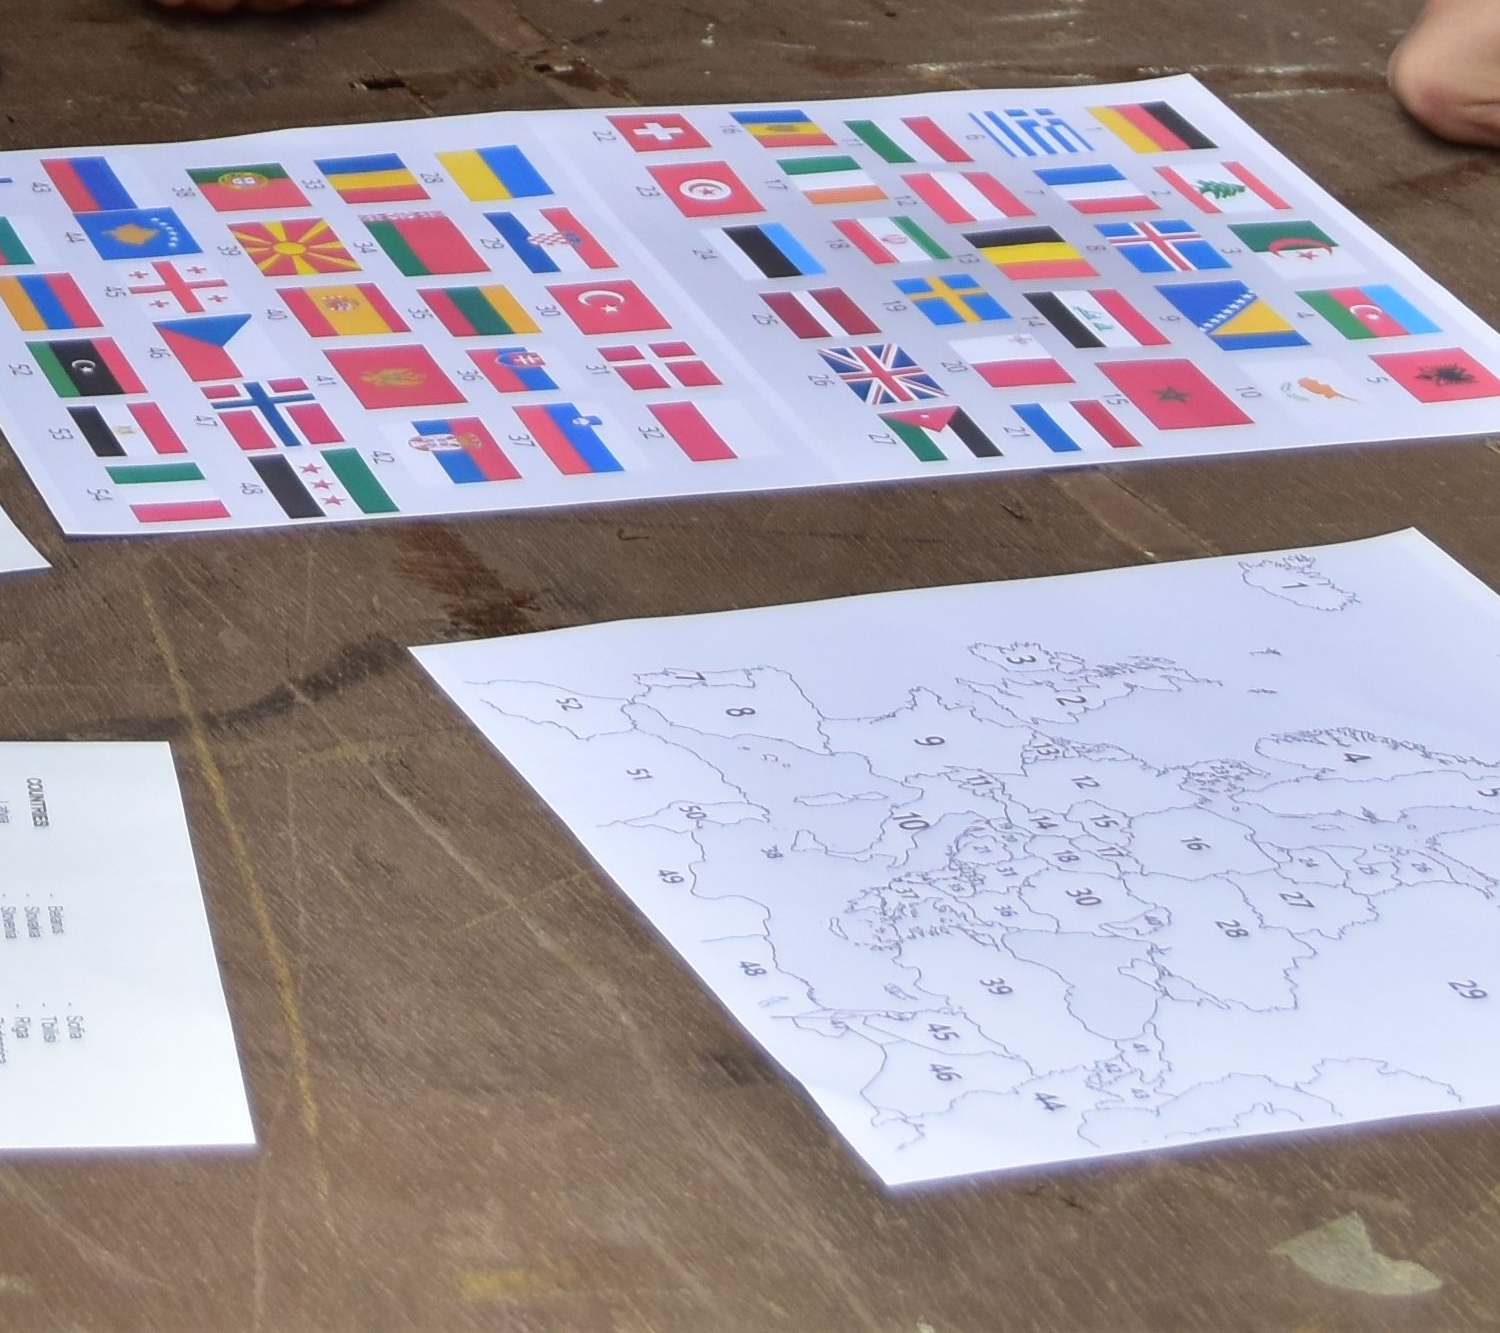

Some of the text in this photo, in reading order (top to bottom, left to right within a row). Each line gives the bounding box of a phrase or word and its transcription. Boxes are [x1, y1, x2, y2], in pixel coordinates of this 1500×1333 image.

[32, 182, 51, 192] 43
[172, 187, 195, 197] 38
[65, 232, 85, 243] 44
[217, 246, 241, 256] 39
[106, 287, 126, 297] 45
[267, 309, 287, 320] 40
[408, 309, 433, 319] 35
[536, 305, 561, 316] 30
[752, 314, 778, 325] 25
[148, 347, 171, 358] 46
[9, 365, 33, 375] 52
[941, 361, 968, 372] 20
[457, 370, 483, 381] 36
[808, 375, 835, 386] 26
[1236, 387, 1261, 398] 10
[1104, 394, 1129, 405] 15
[194, 416, 218, 426] 47
[49, 429, 74, 439] 53
[638, 427, 664, 439] 32
[1003, 427, 1030, 437] 21
[508, 435, 536, 447] 37
[868, 433, 896, 444] 27
[371, 451, 395, 464] 42
[242, 483, 263, 494] 48
[87, 489, 113, 501] 54
[1006, 655, 1037, 664] 3
[1055, 696, 1087, 706] 2
[726, 707, 756, 717] 8
[914, 736, 945, 746] 9
[1344, 753, 1372, 763] 4
[1071, 775, 1100, 789] 12
[891, 812, 929, 831] 10
[1181, 837, 1211, 851] 16
[1065, 888, 1102, 906] 30
[1279, 892, 1315, 908] 27
[0, 906, 17, 940] Slovenia
[24, 906, 42, 938] Slovakia
[1215, 920, 1249, 938] 28
[740, 961, 767, 976] 48
[979, 978, 1013, 995] 39
[1448, 980, 1488, 999] 29
[11, 1017, 31, 1039] Riga
[41, 1016, 59, 1043] Tbilisi
[66, 1016, 85, 1040] Sofia
[928, 1024, 960, 1041] 45
[930, 1064, 962, 1082] 46
[1035, 1093, 1067, 1112] 44
